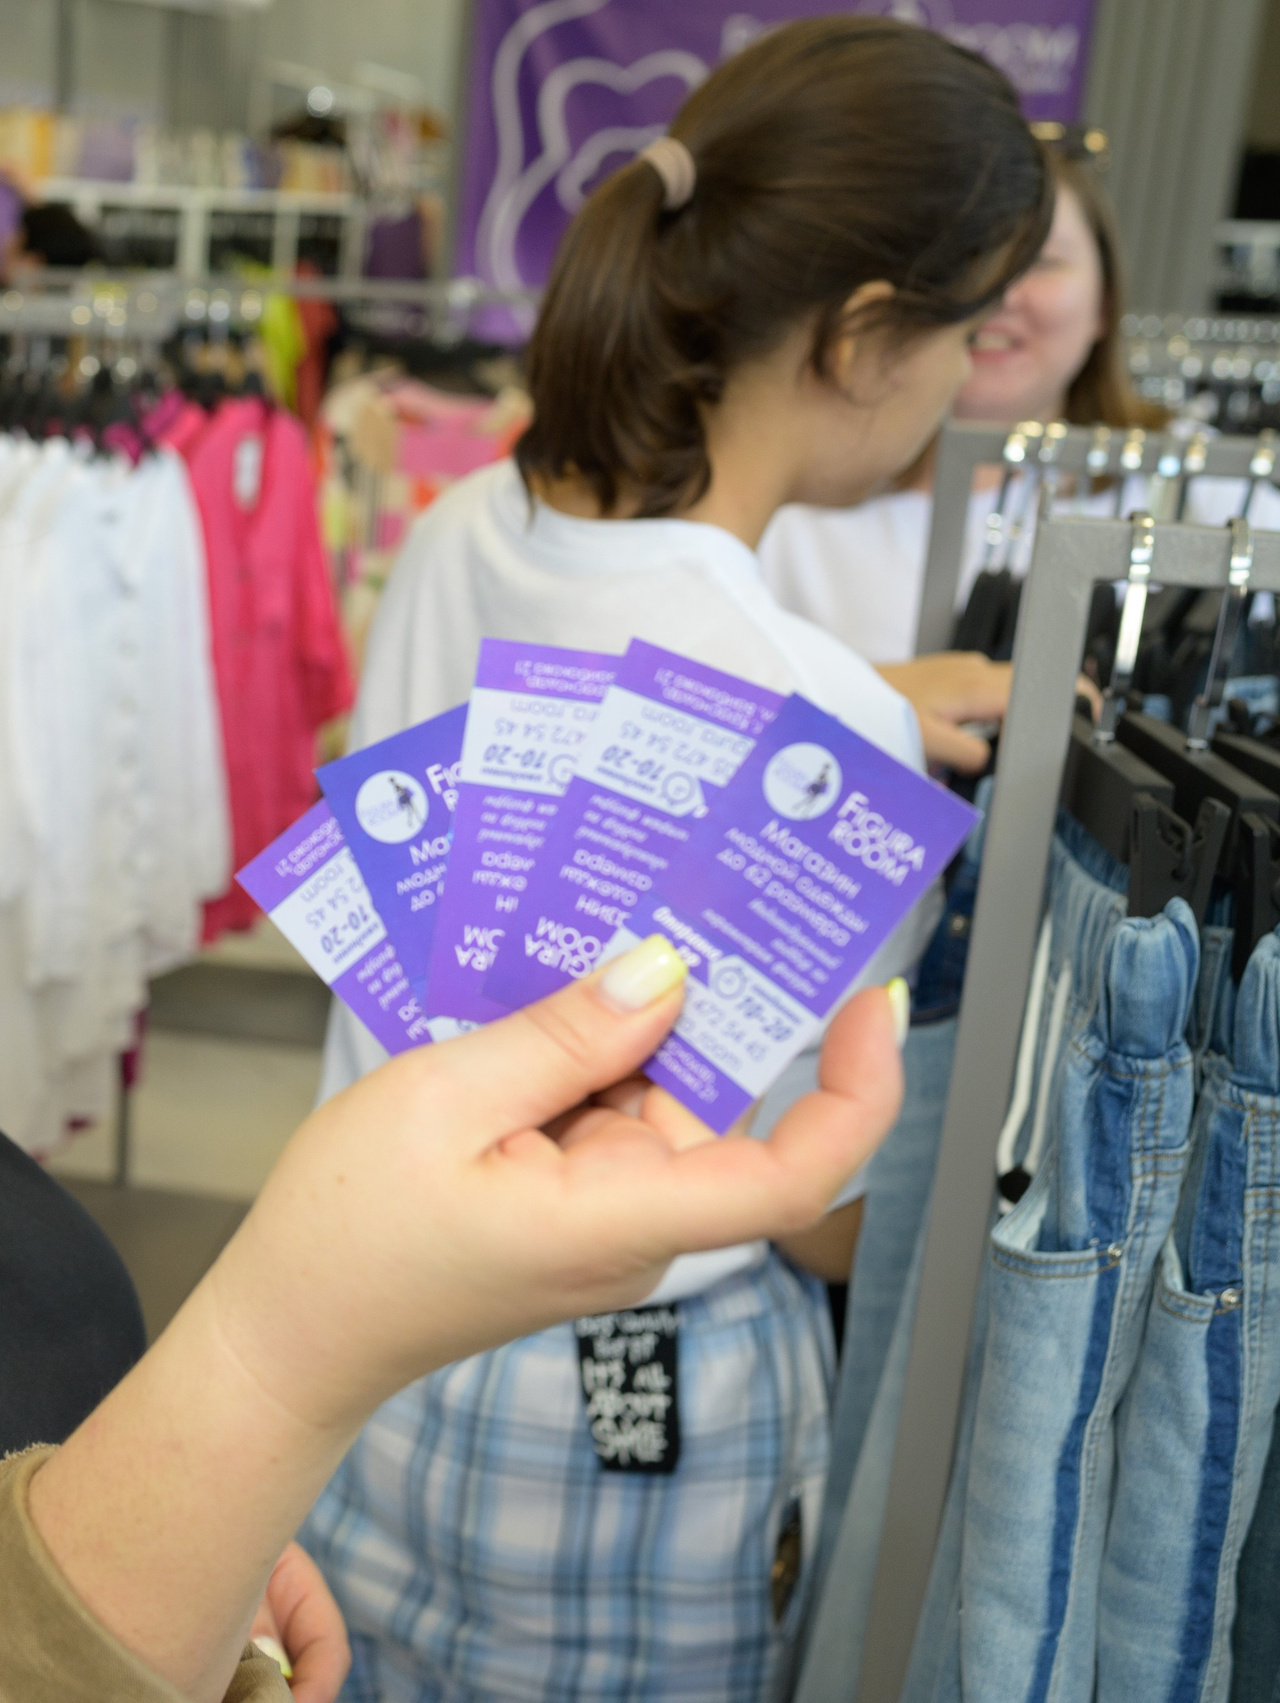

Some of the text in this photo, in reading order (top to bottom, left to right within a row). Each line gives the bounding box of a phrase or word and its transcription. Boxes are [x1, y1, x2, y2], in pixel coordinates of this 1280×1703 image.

[494, 717, 518, 737] 45
[523, 723, 545, 742] 54
[620, 721, 643, 741] 45
[646, 732, 671, 754] 54
[483, 743, 547, 769] 10-20
[601, 744, 665, 782] 10-20
[836, 790, 926, 871] FIGURA
[275, 858, 293, 877] 21
[715, 848, 747, 871] до
[759, 819, 862, 899] Магазин
[826, 815, 913, 890] ROOM
[305, 887, 350, 929] 54 45
[320, 904, 370, 955] 10-20
[649, 902, 724, 966] Отправк
[735, 995, 794, 1043] 10-20
